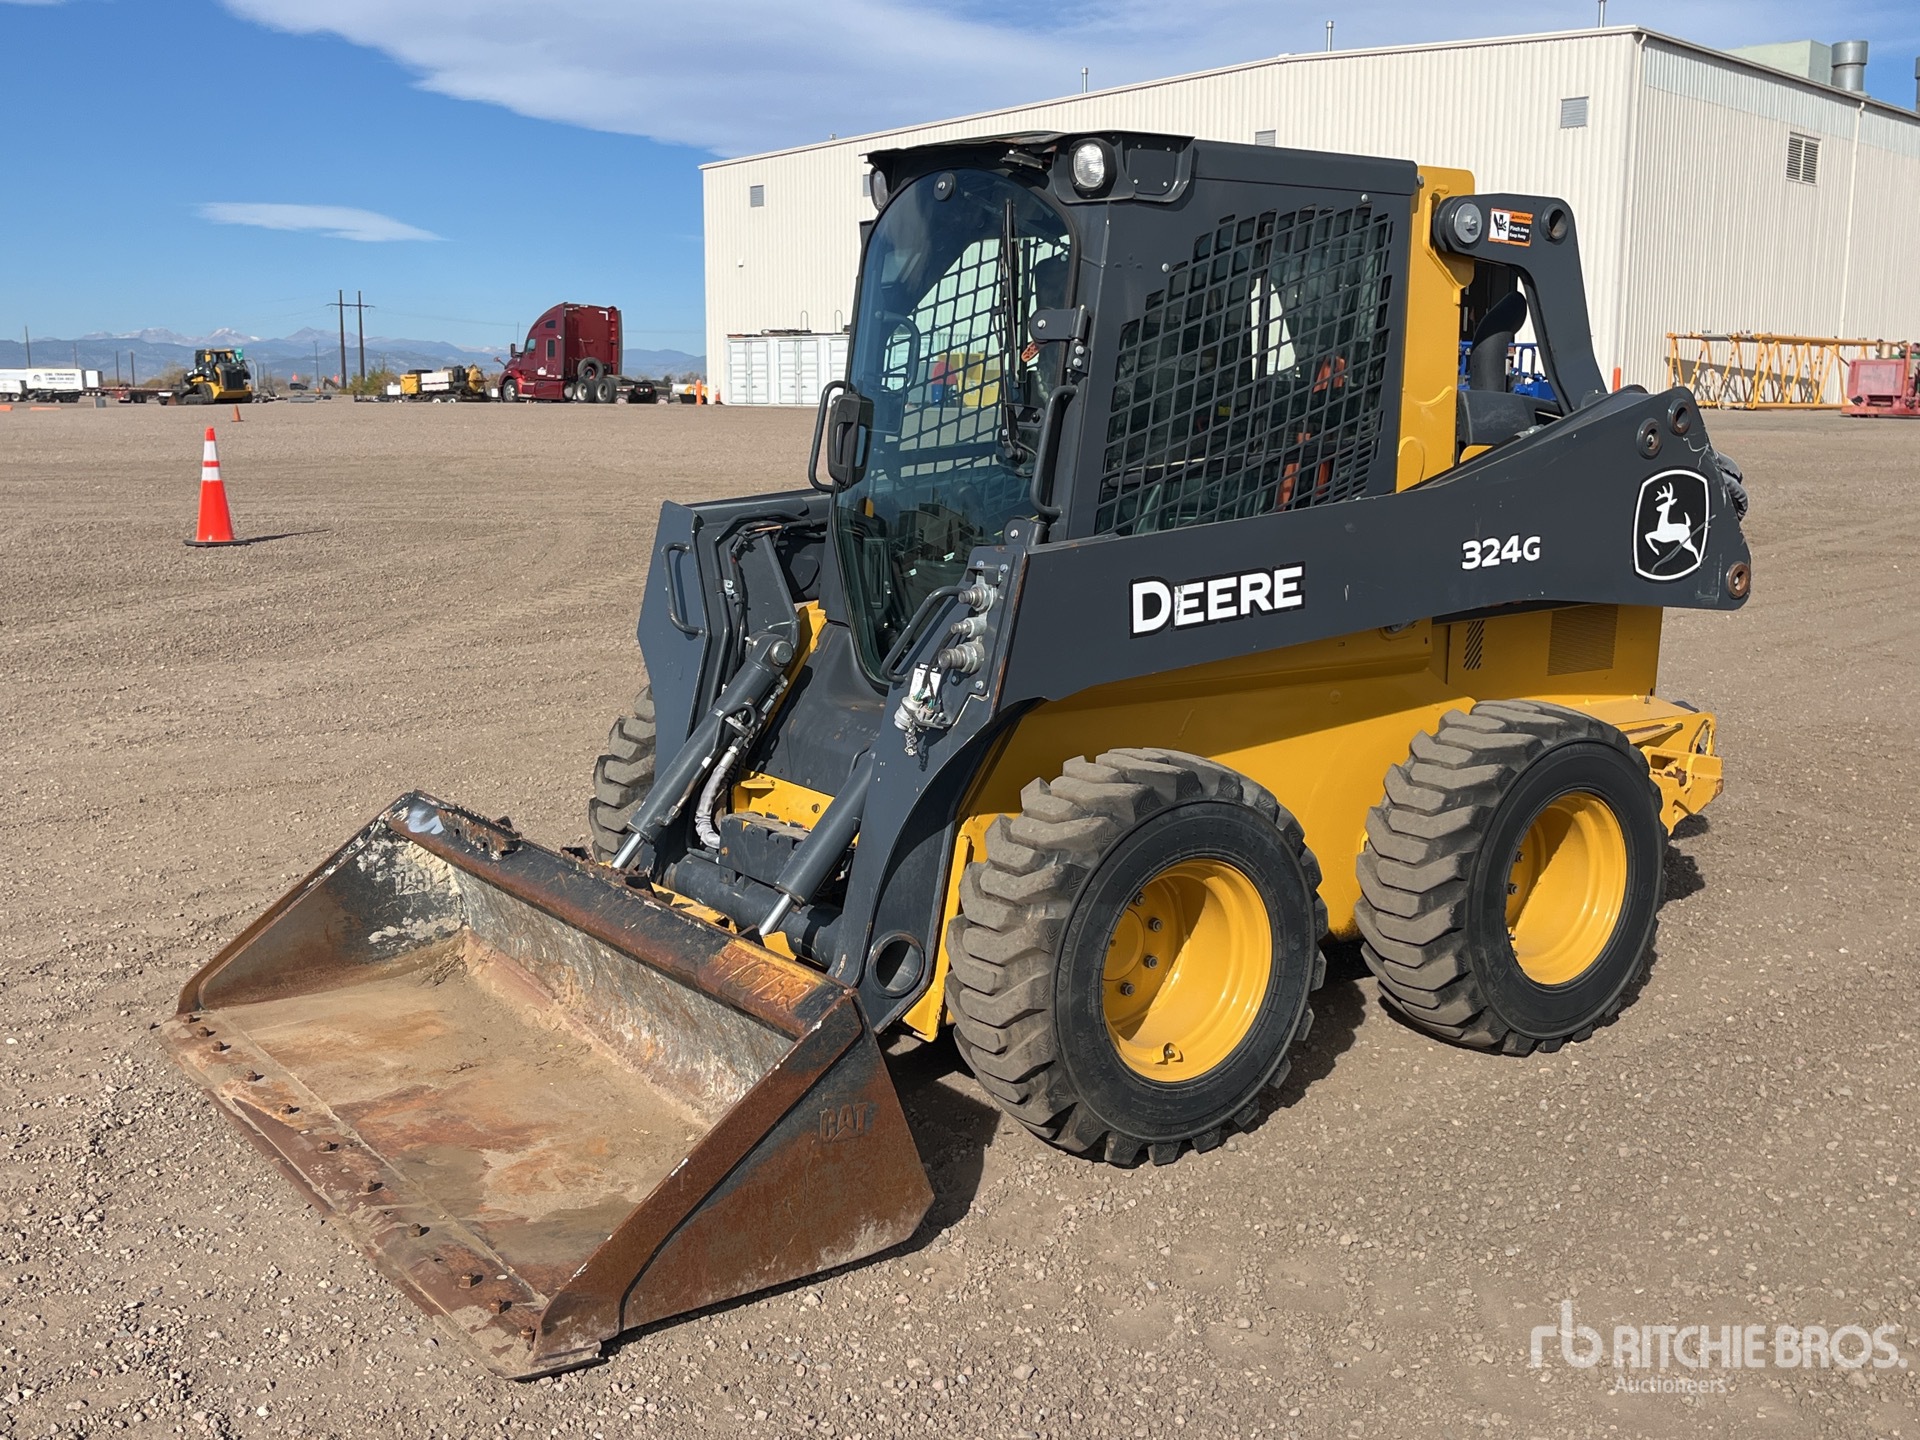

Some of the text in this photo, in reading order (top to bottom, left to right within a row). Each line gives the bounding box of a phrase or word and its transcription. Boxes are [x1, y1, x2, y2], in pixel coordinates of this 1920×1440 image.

[1461, 535, 1542, 570] 324G
[1131, 565, 1304, 635] DEERE
[820, 1102, 869, 1142] CAT
